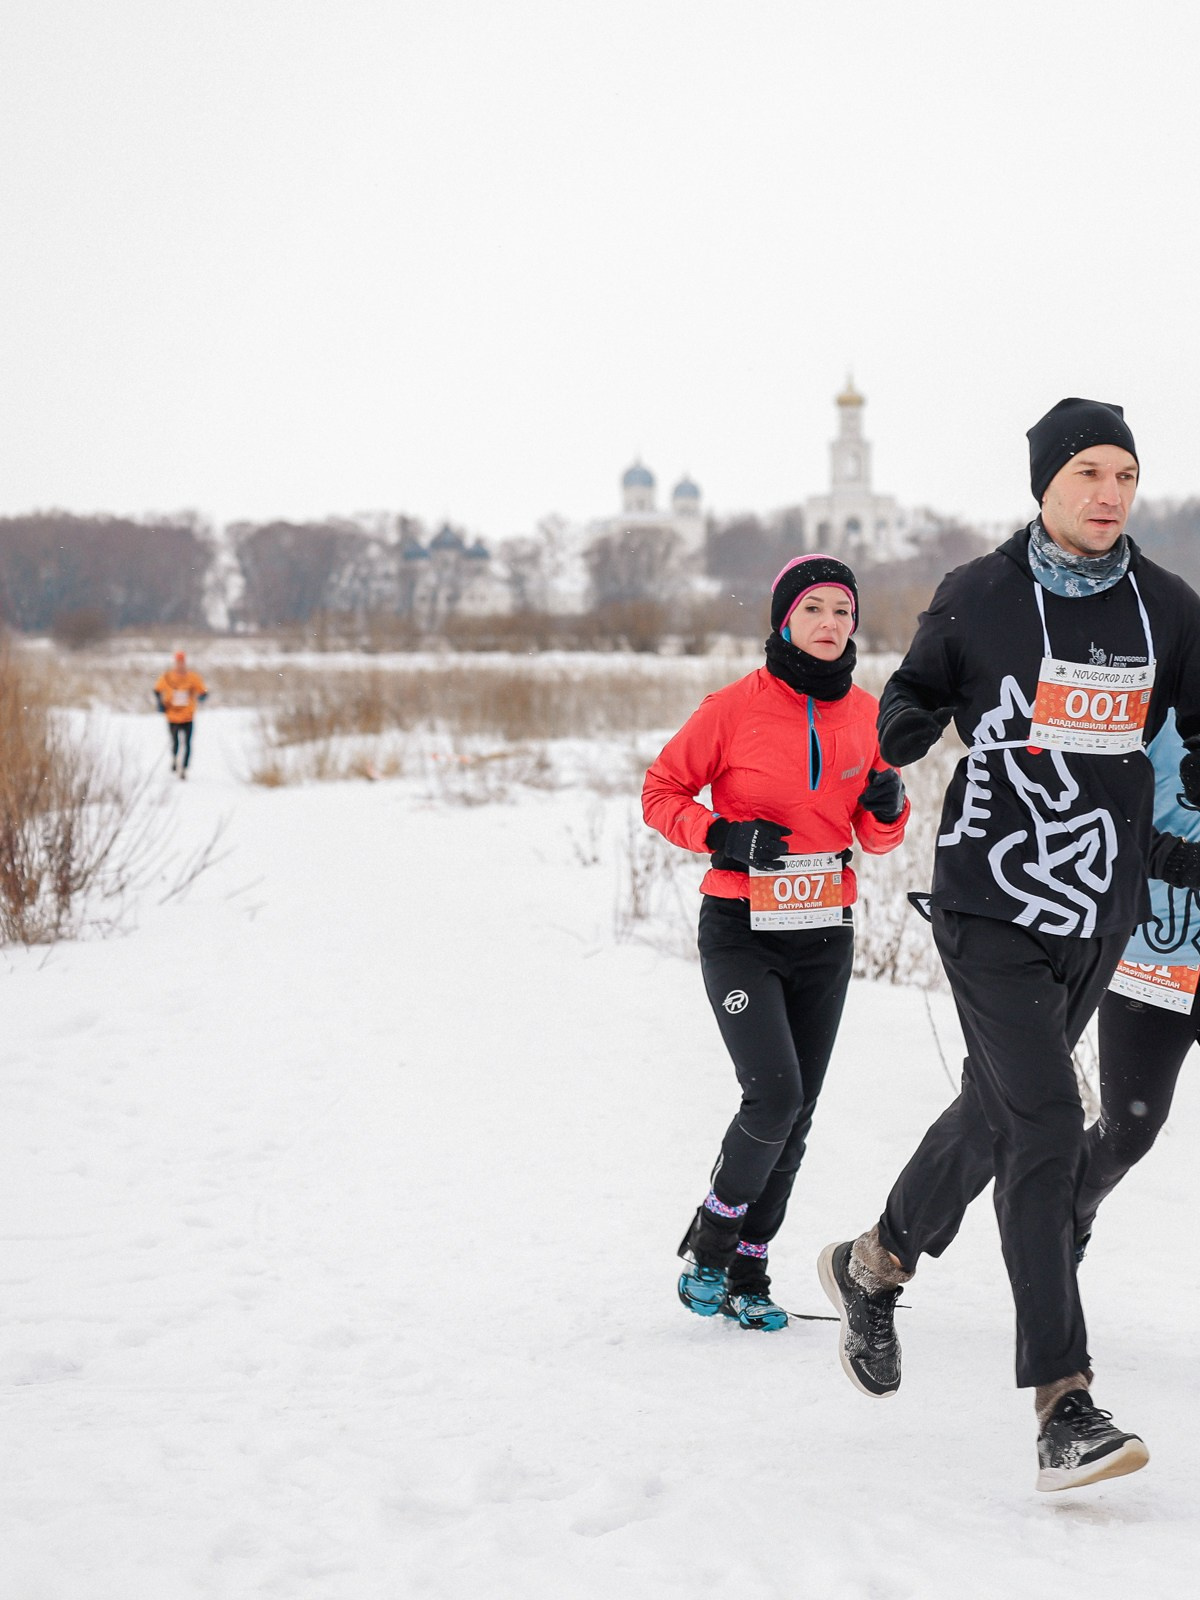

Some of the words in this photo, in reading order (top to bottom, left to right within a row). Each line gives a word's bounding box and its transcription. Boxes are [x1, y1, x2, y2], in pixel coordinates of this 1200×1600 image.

[1072, 669, 1120, 683] NOVGOROD
[1121, 674, 1135, 684] ICE
[1065, 689, 1130, 722] 001
[1048, 718, 1107, 730] АЛАДАШВИЛИ
[1108, 722, 1138, 731] МИХАИЛ
[784, 859, 812, 869] VGOROD
[812, 858, 823, 868] ICE
[773, 874, 826, 903] 007
[804, 901, 823, 909] ЮЛИЯ
[1115, 964, 1152, 981] АРАФУЛИН
[1152, 975, 1181, 990] РУСЛАН
